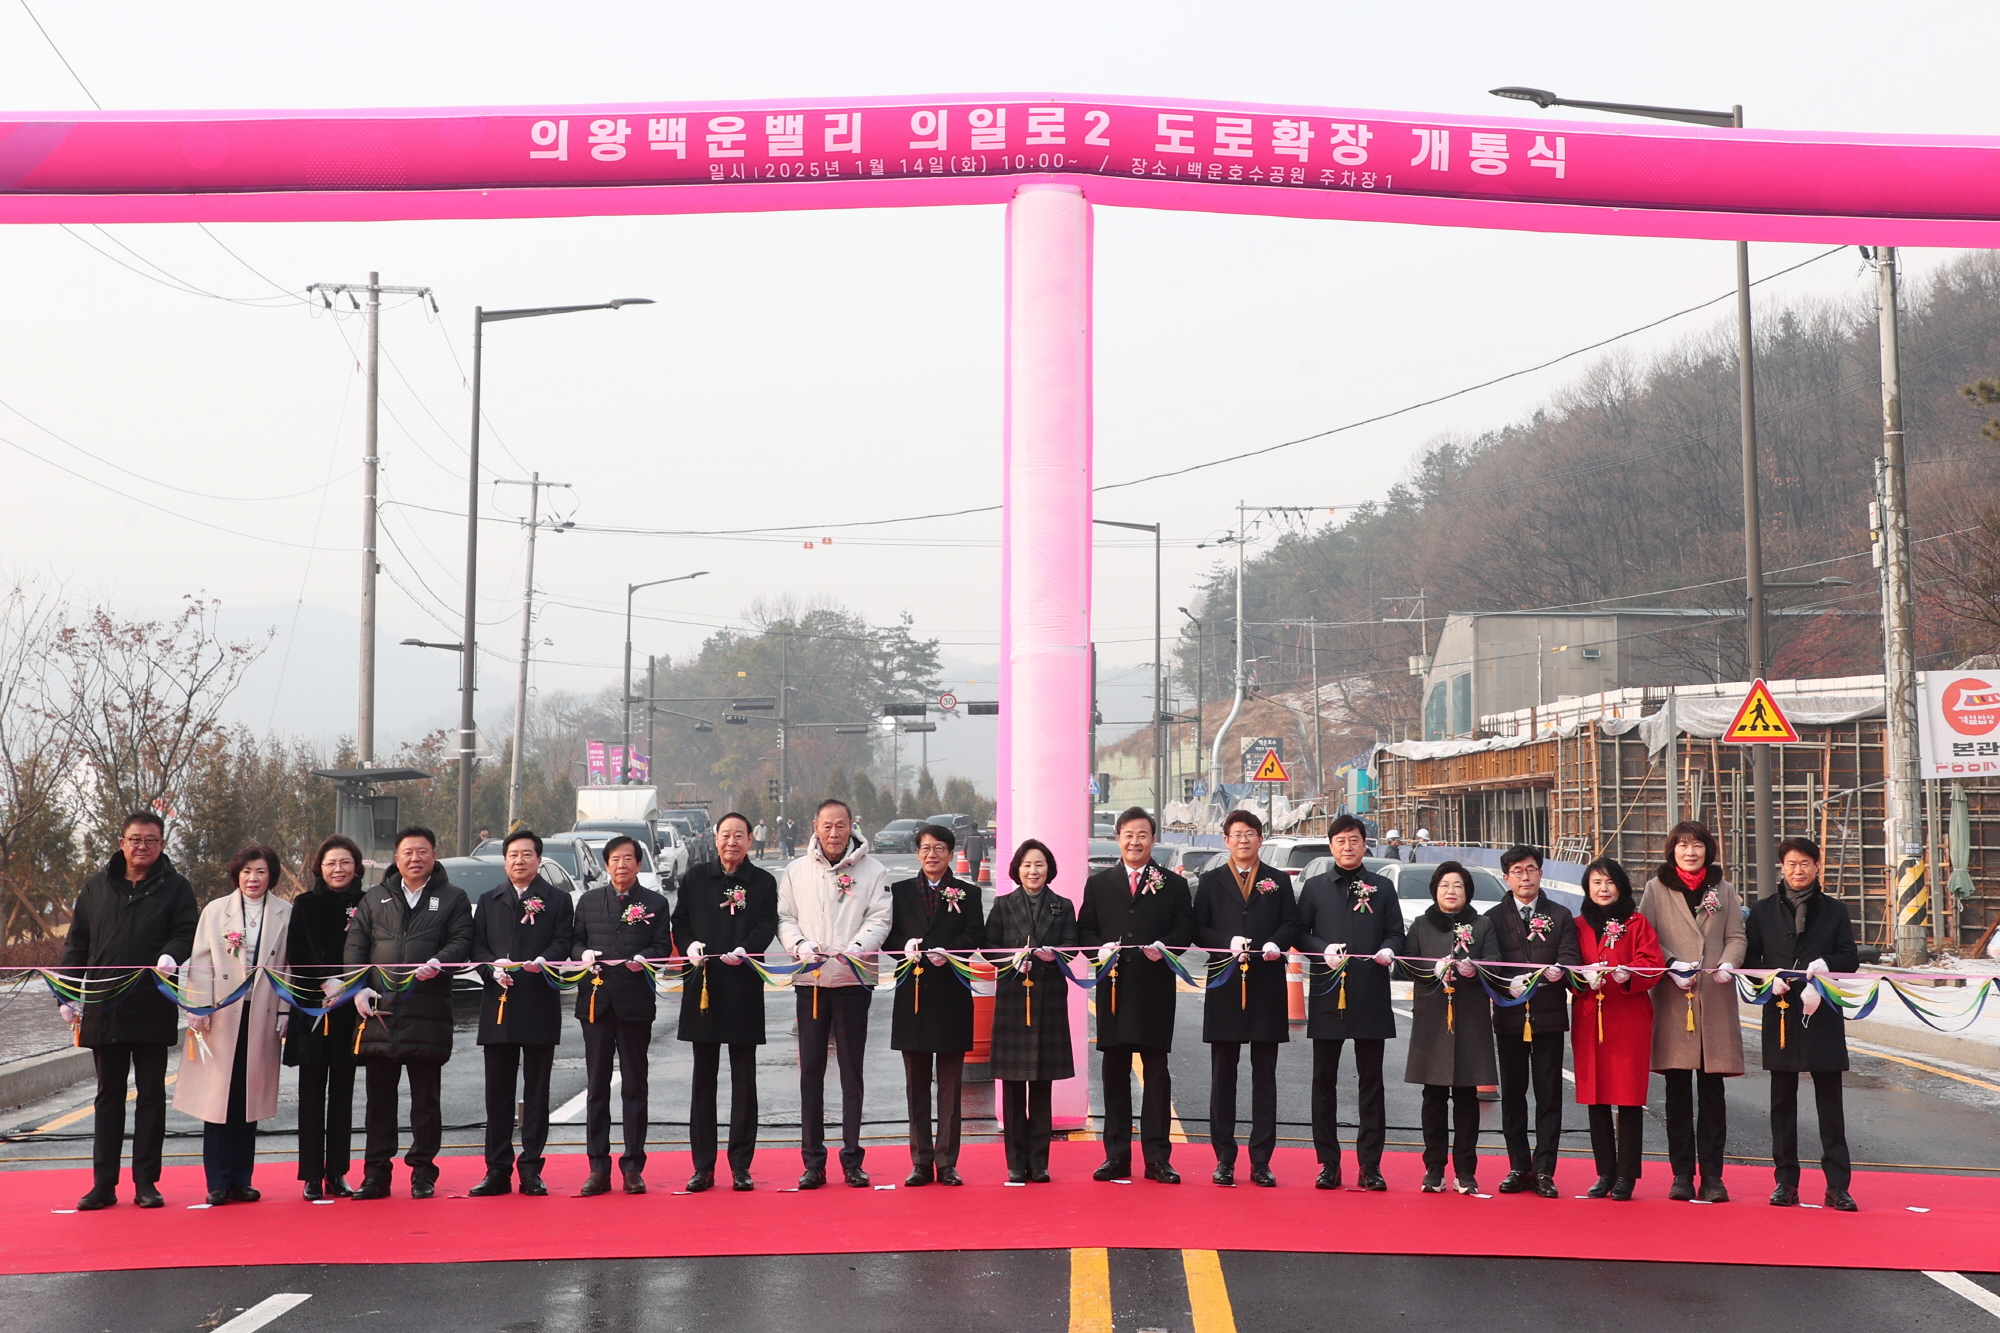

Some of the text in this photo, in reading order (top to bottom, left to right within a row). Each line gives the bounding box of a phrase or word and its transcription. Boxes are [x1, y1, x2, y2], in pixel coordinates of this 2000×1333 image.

[529, 107, 1567, 179] 의왕백운밸리 의일로2 도로확장 개통식
[708, 162, 745, 180] 일시
[855, 158, 884, 176] 1월
[899, 154, 987, 174] 14일(화)
[1001, 152, 1078, 170] 10:00~
[1958, 714, 1995, 726] 계절밥상
[1952, 741, 2000, 757] 본관
